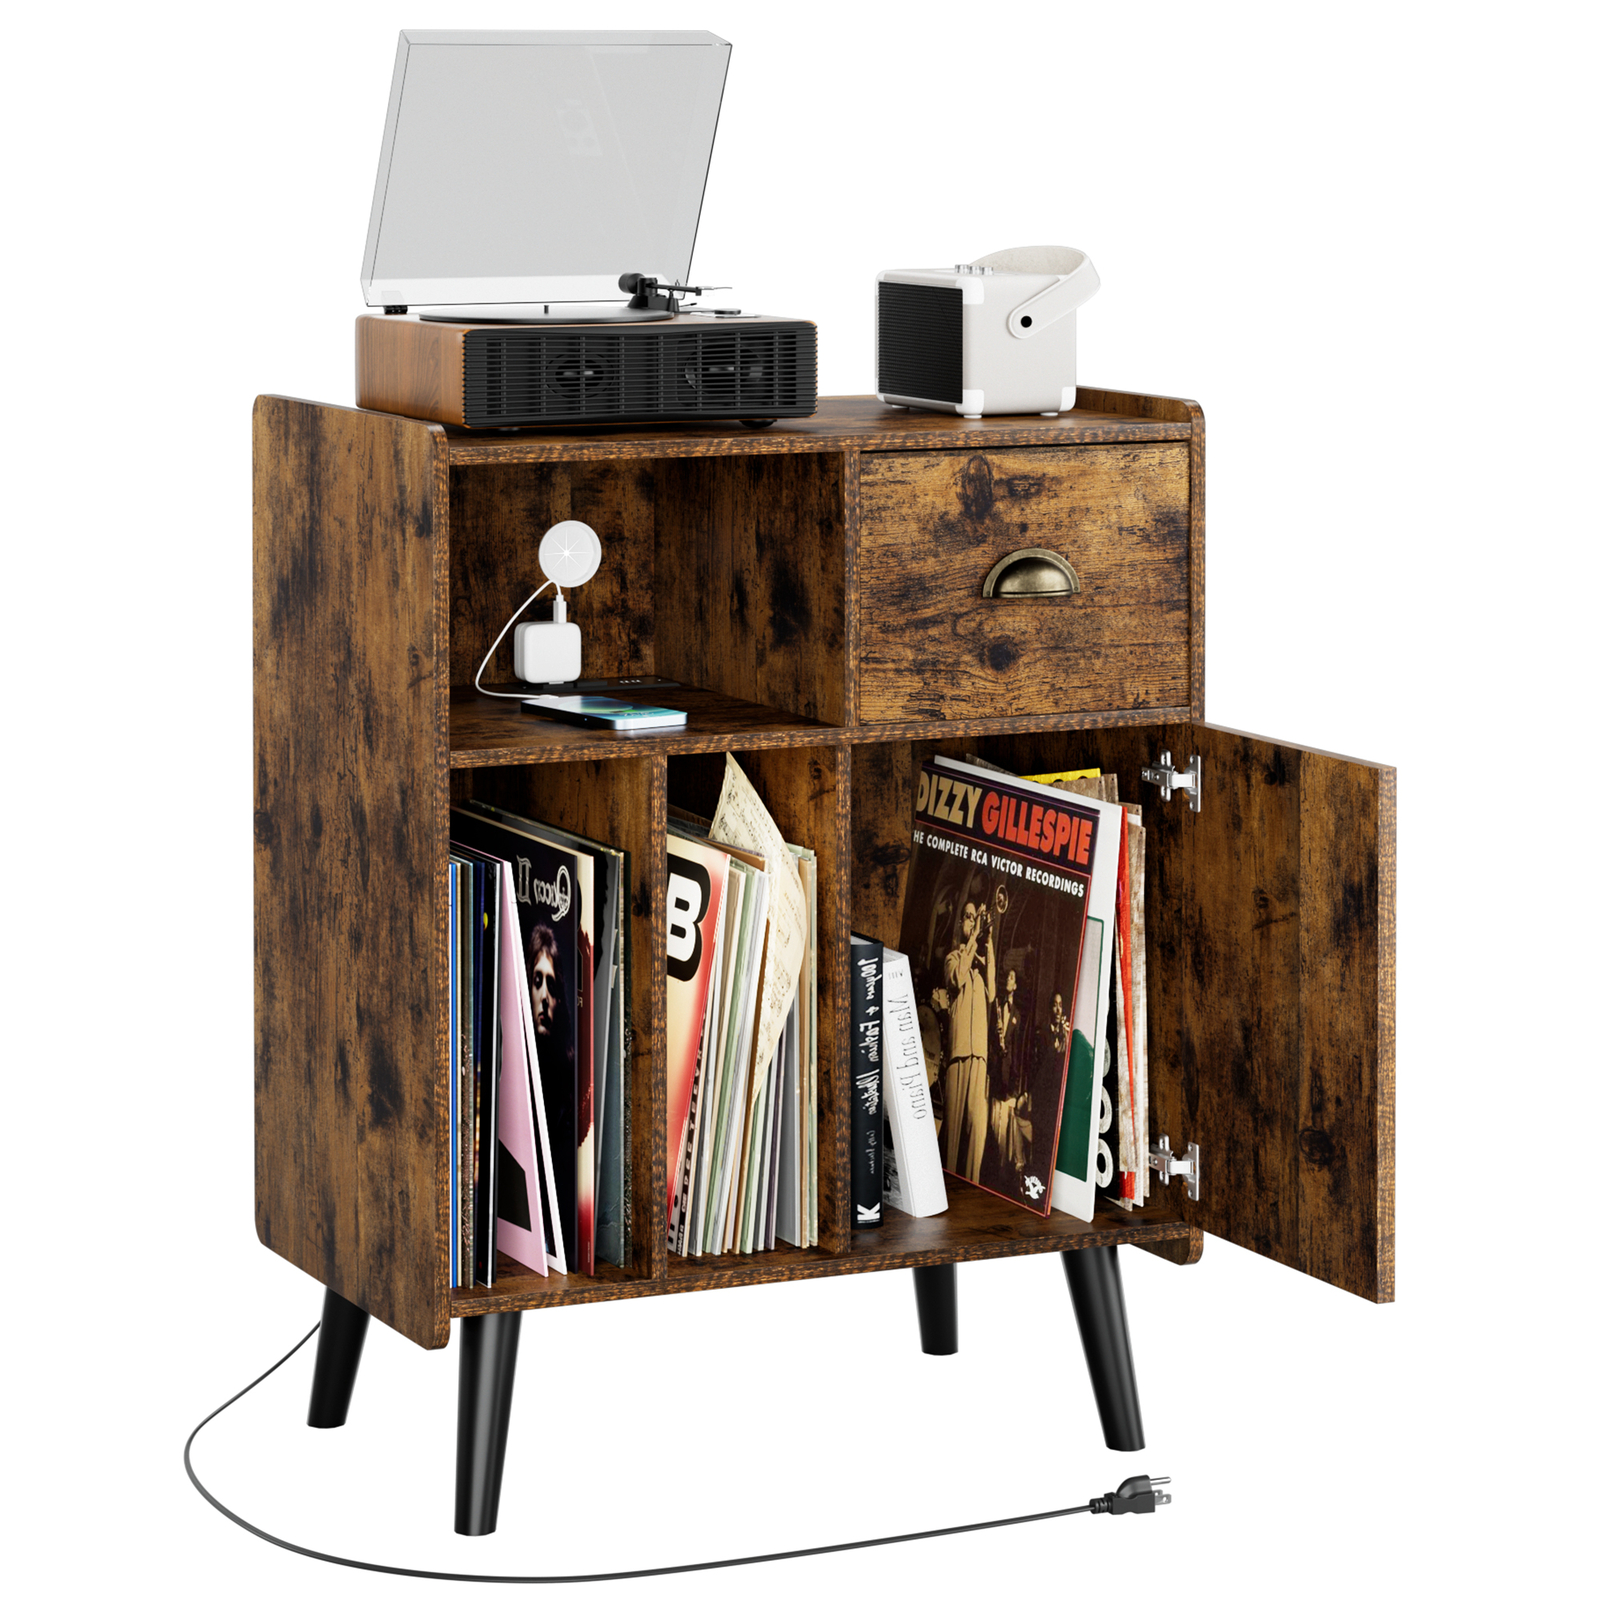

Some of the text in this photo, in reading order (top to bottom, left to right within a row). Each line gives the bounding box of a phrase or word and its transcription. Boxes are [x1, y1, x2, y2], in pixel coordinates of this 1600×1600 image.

[916, 770, 1093, 865] DIZZY GILLESPIE
[913, 829, 1085, 898] HE COMPLETE RCA VICTOR RECORDINGS
